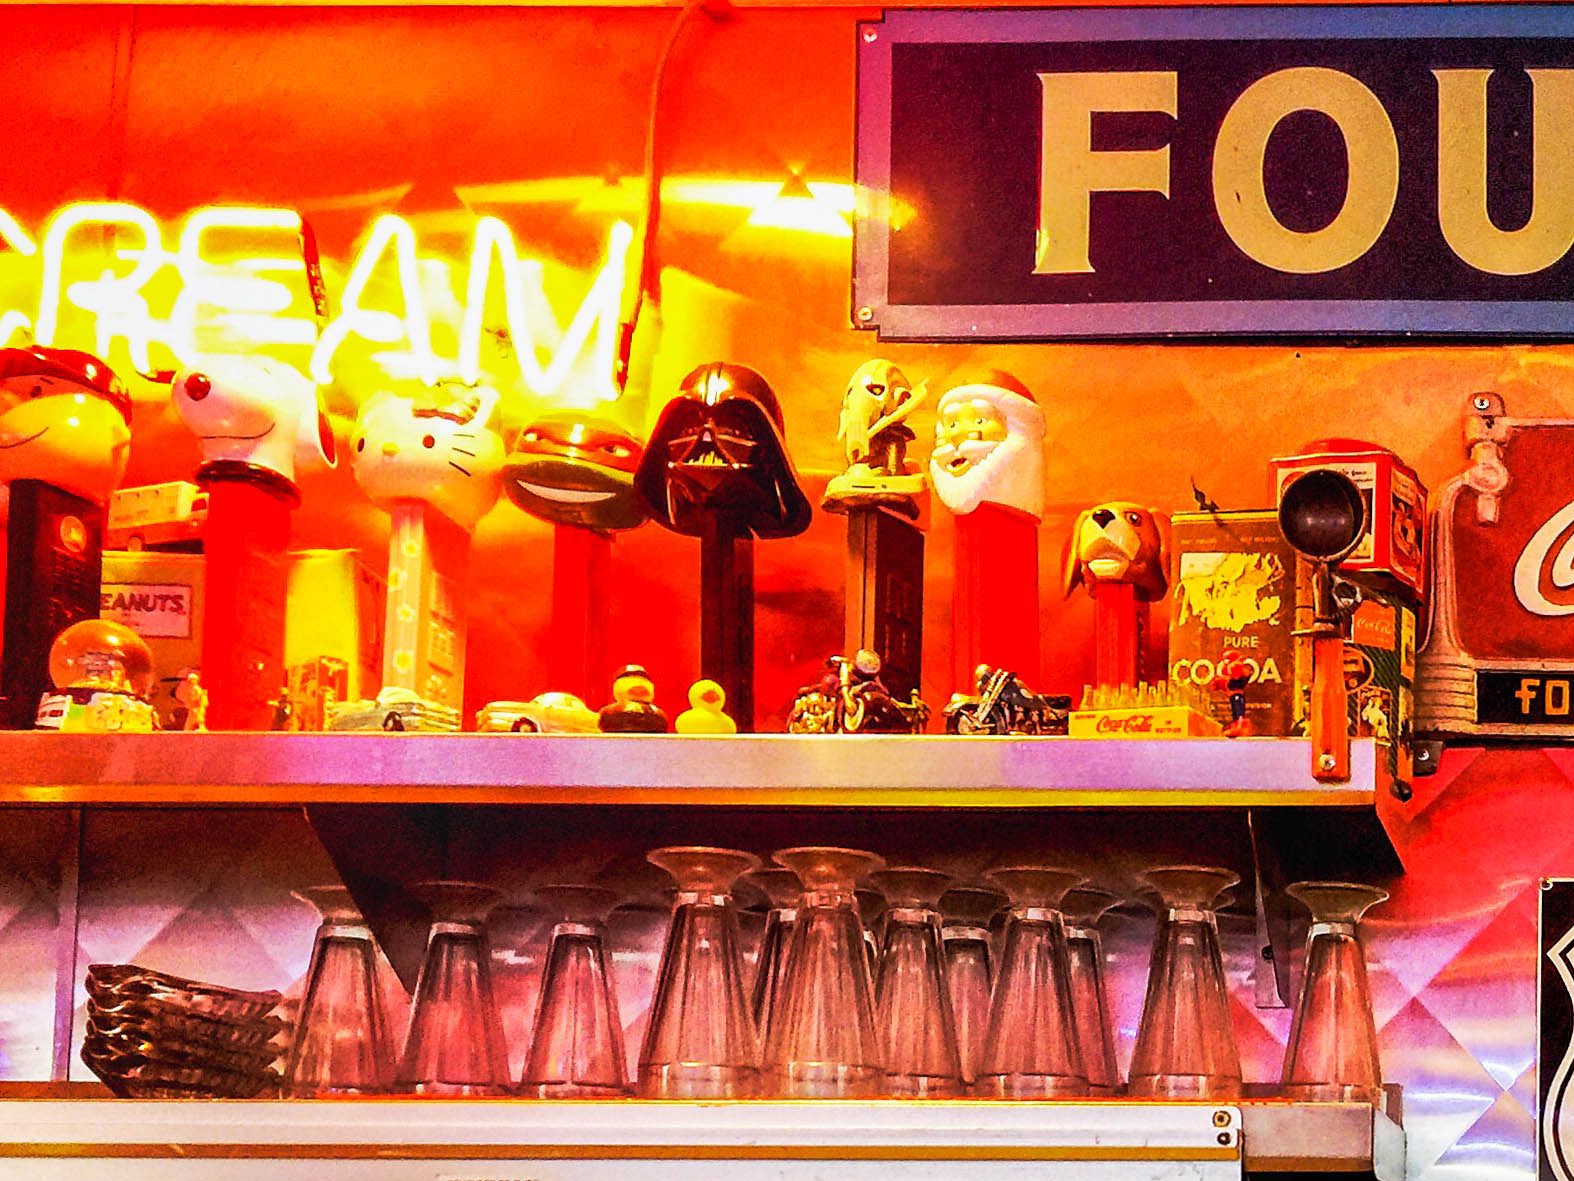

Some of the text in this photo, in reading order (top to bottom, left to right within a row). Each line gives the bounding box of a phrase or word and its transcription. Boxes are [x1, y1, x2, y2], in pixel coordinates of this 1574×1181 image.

[0, 200, 634, 402] REAM
[100, 592, 185, 614] EANUTS
[1223, 635, 1260, 648] PURE
